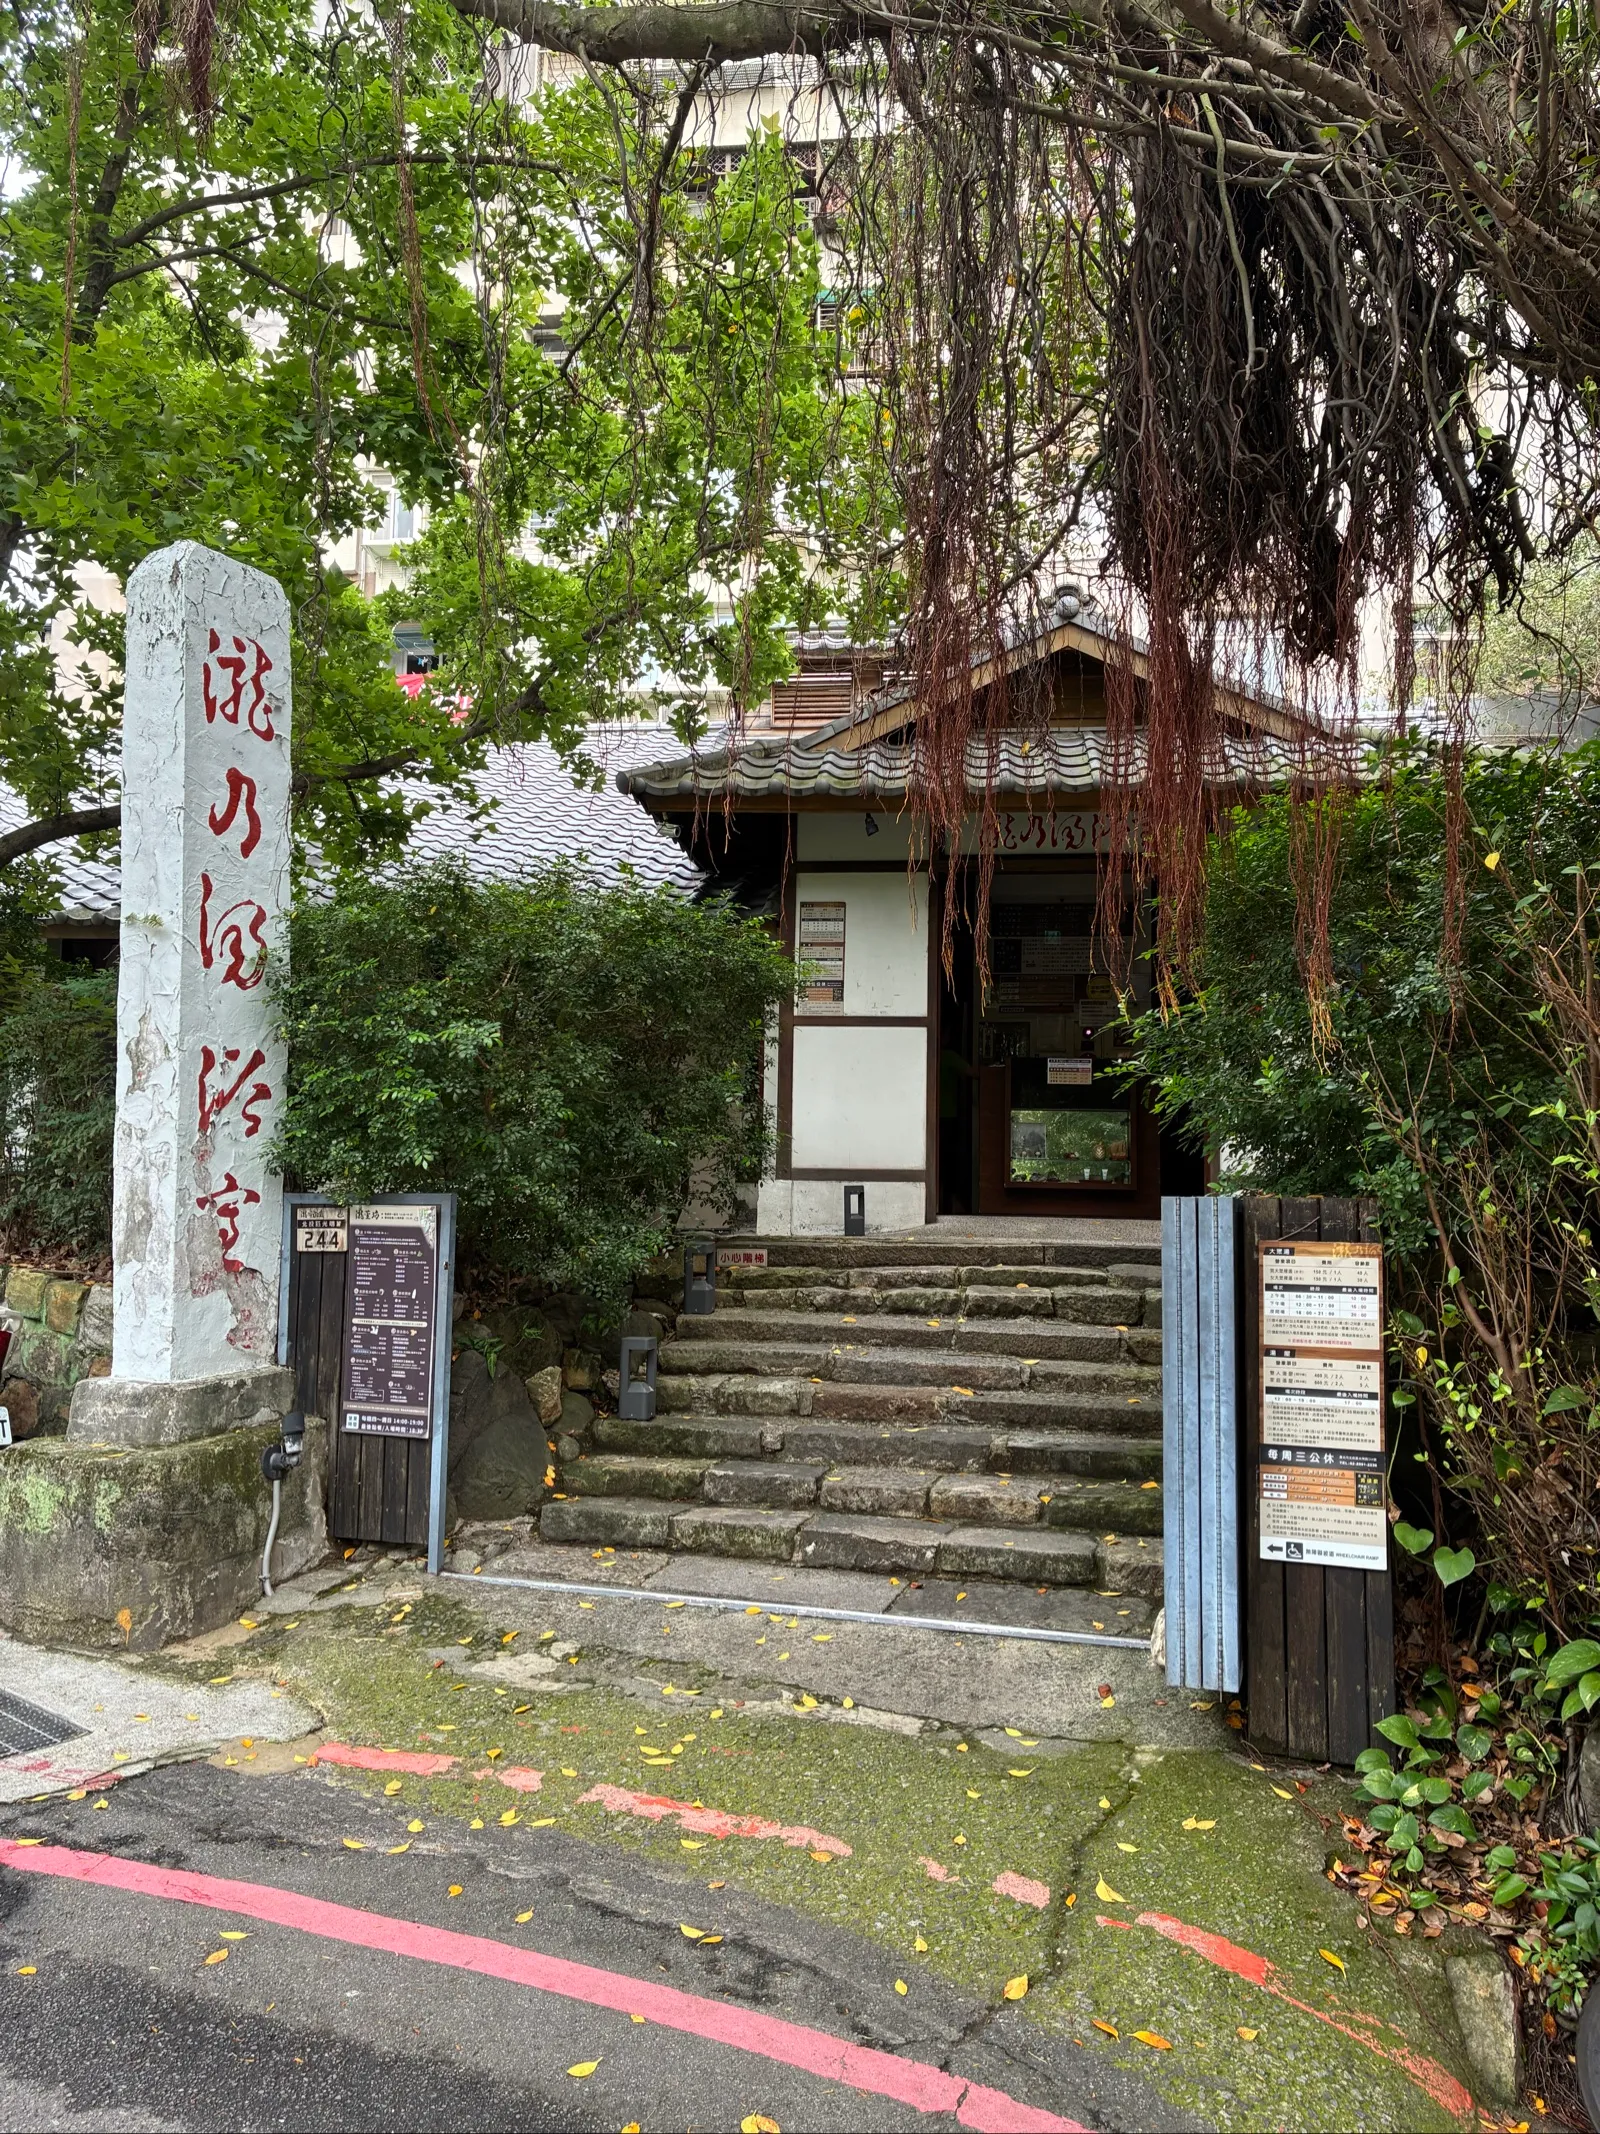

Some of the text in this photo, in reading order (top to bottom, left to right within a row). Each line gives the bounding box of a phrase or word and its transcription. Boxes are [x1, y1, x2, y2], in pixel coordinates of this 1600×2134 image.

[305, 1231, 339, 1248] 244
[720, 1253, 764, 1263] 小心階梯
[1268, 1448, 1334, 1464] 每周三公休
